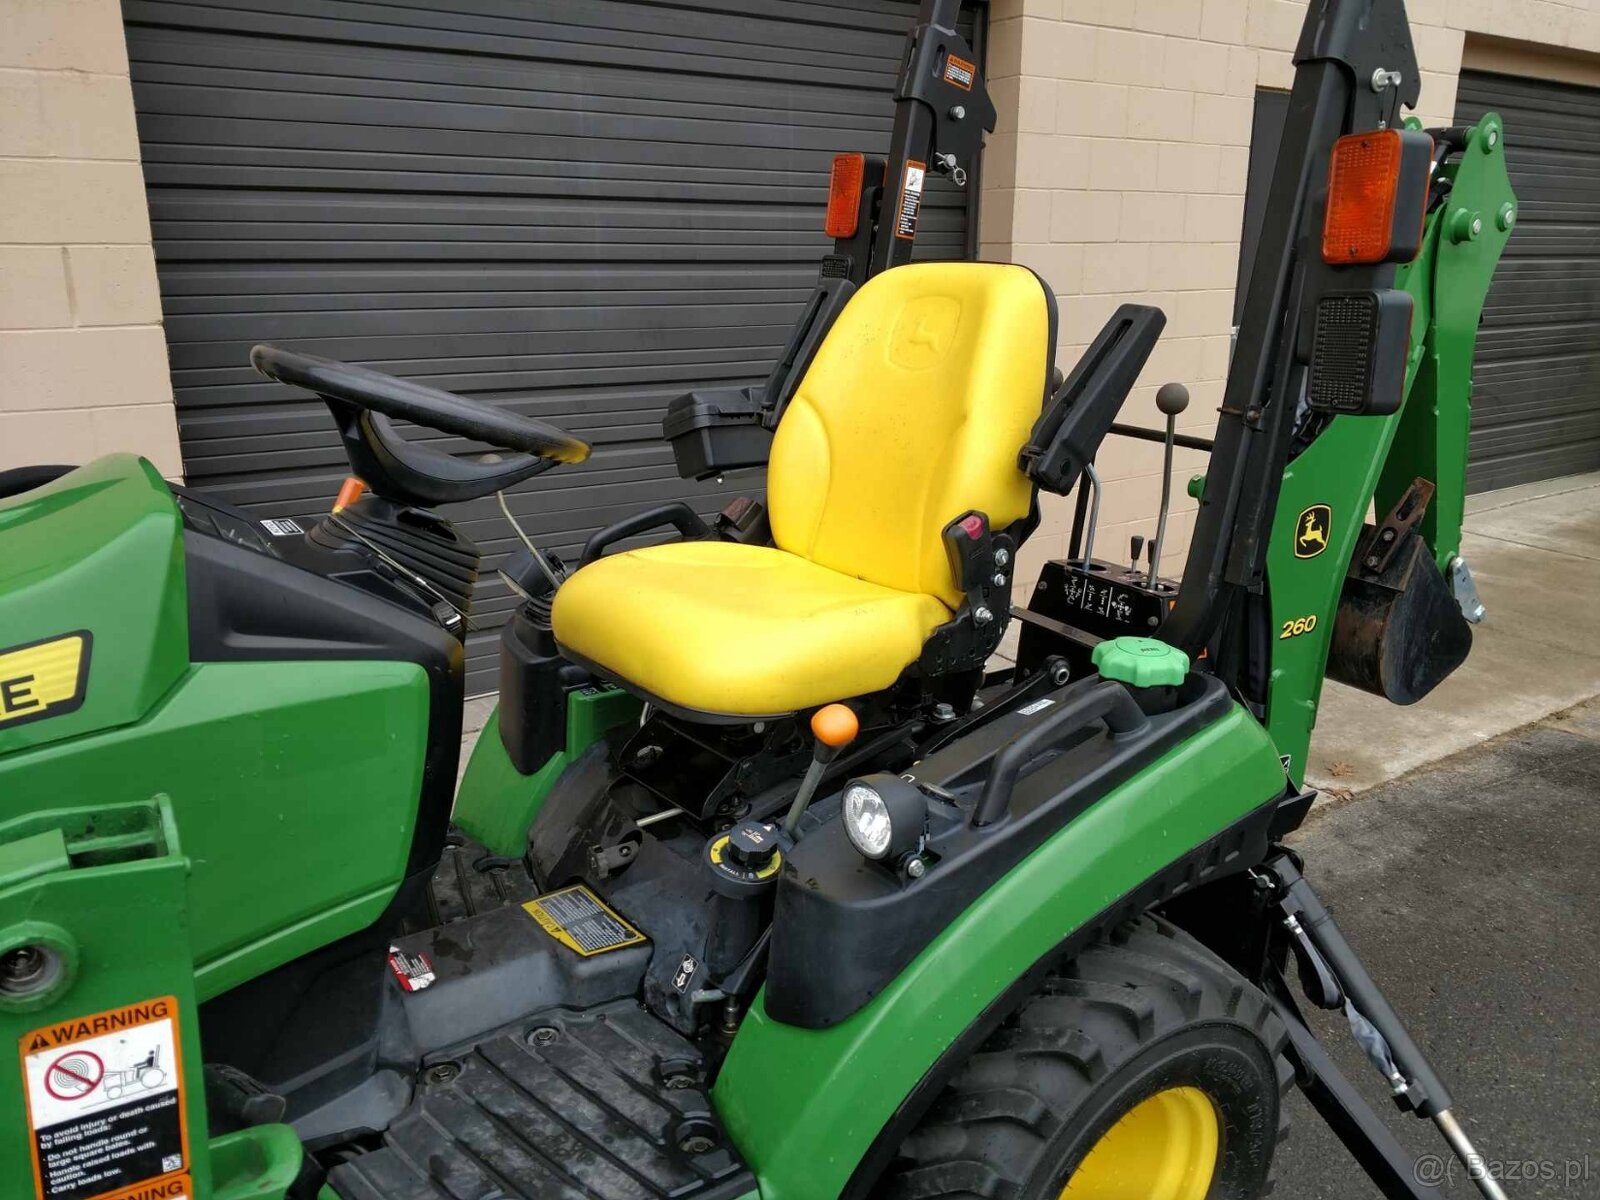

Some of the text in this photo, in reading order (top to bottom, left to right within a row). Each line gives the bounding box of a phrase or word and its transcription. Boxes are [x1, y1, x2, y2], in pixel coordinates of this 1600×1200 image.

[1280, 615, 1317, 639] 260
[52, 1002, 168, 1043] WARNING
[40, 1134, 52, 1142] To
[54, 1125, 79, 1139] avoid
[80, 1119, 107, 1131] injury
[119, 1107, 143, 1119] death
[145, 1097, 176, 1111] caused
[40, 1141, 52, 1150] by
[54, 1133, 82, 1145] falling
[48, 1153, 60, 1161] Do
[62, 1147, 77, 1157] not
[79, 1139, 109, 1152] handle
[111, 1129, 136, 1142] round
[48, 1157, 71, 1168] large
[73, 1147, 103, 1160] square
[50, 1141, 155, 1178] Handle raised loads with
[51, 1182, 76, 1194] Carry
[78, 1174, 102, 1186] loads
